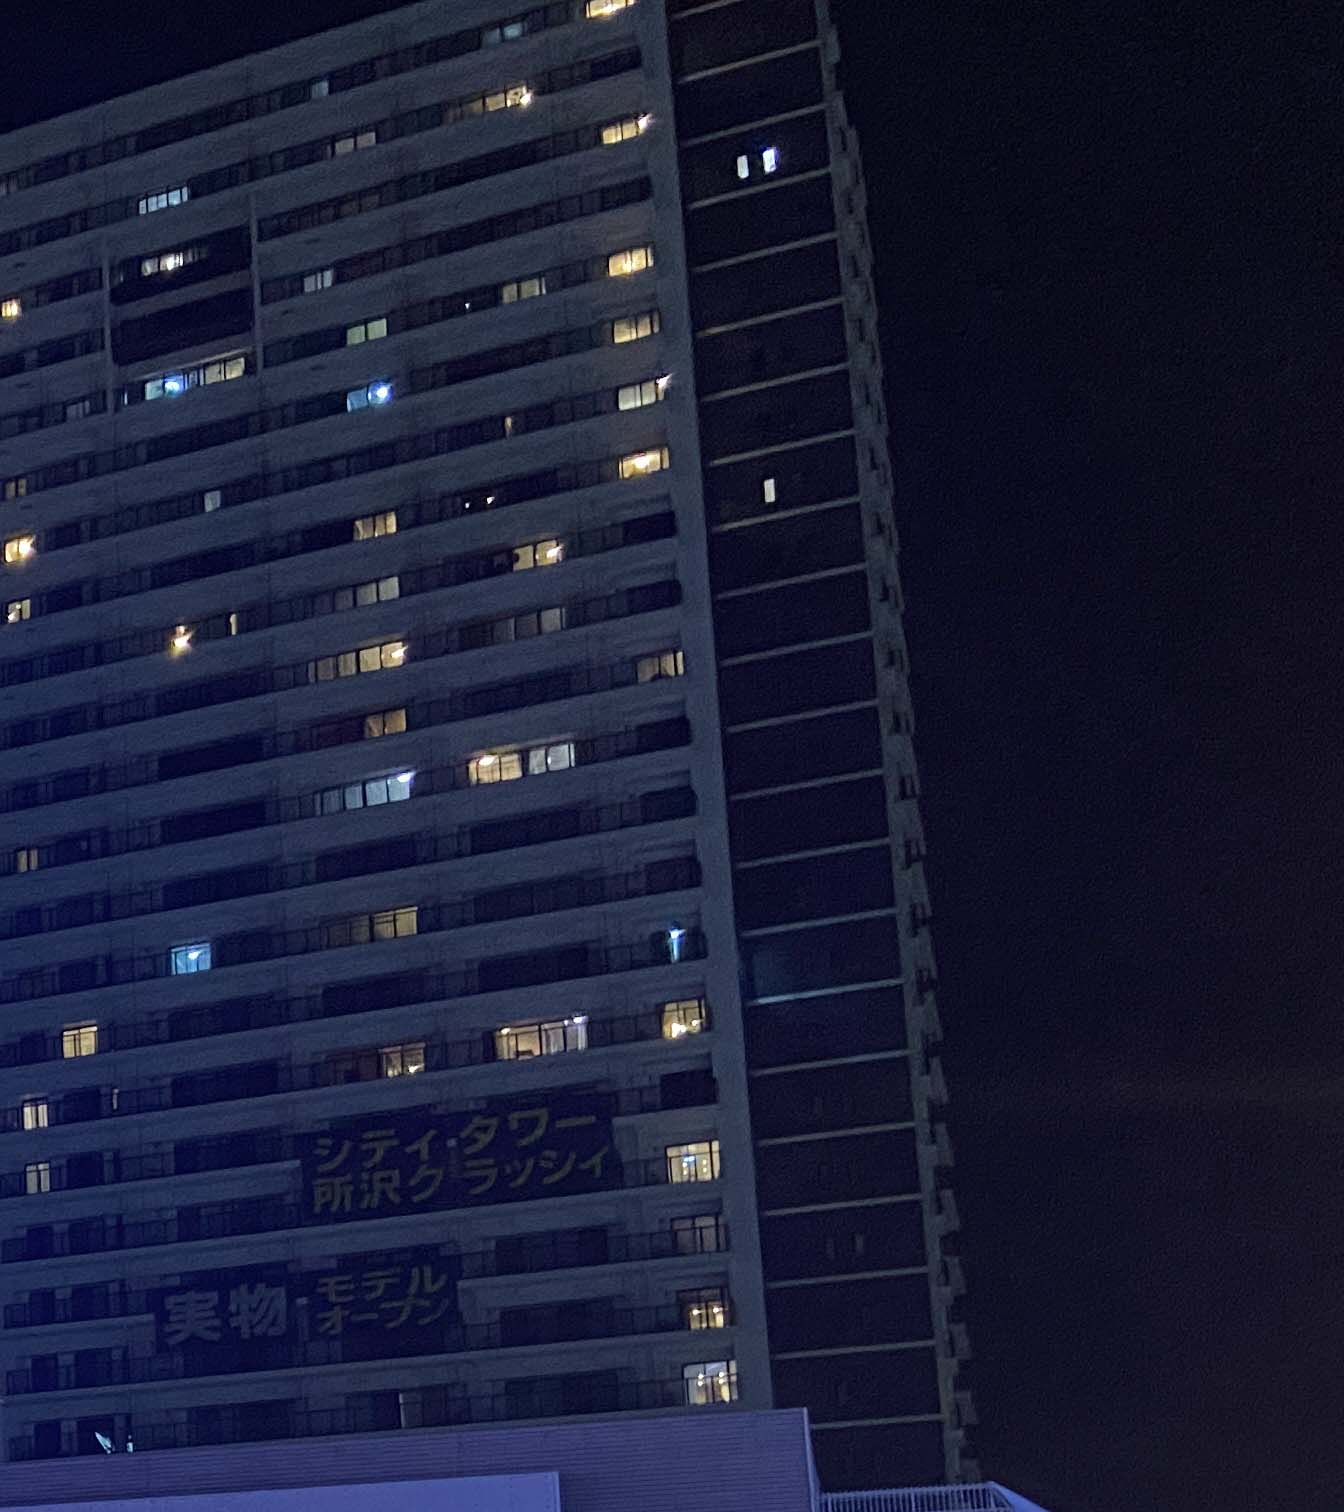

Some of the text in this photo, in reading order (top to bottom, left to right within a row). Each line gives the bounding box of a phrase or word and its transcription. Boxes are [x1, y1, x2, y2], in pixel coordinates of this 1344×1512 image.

[318, 1264, 447, 1302] モデル
[164, 1283, 288, 1345] 実物
